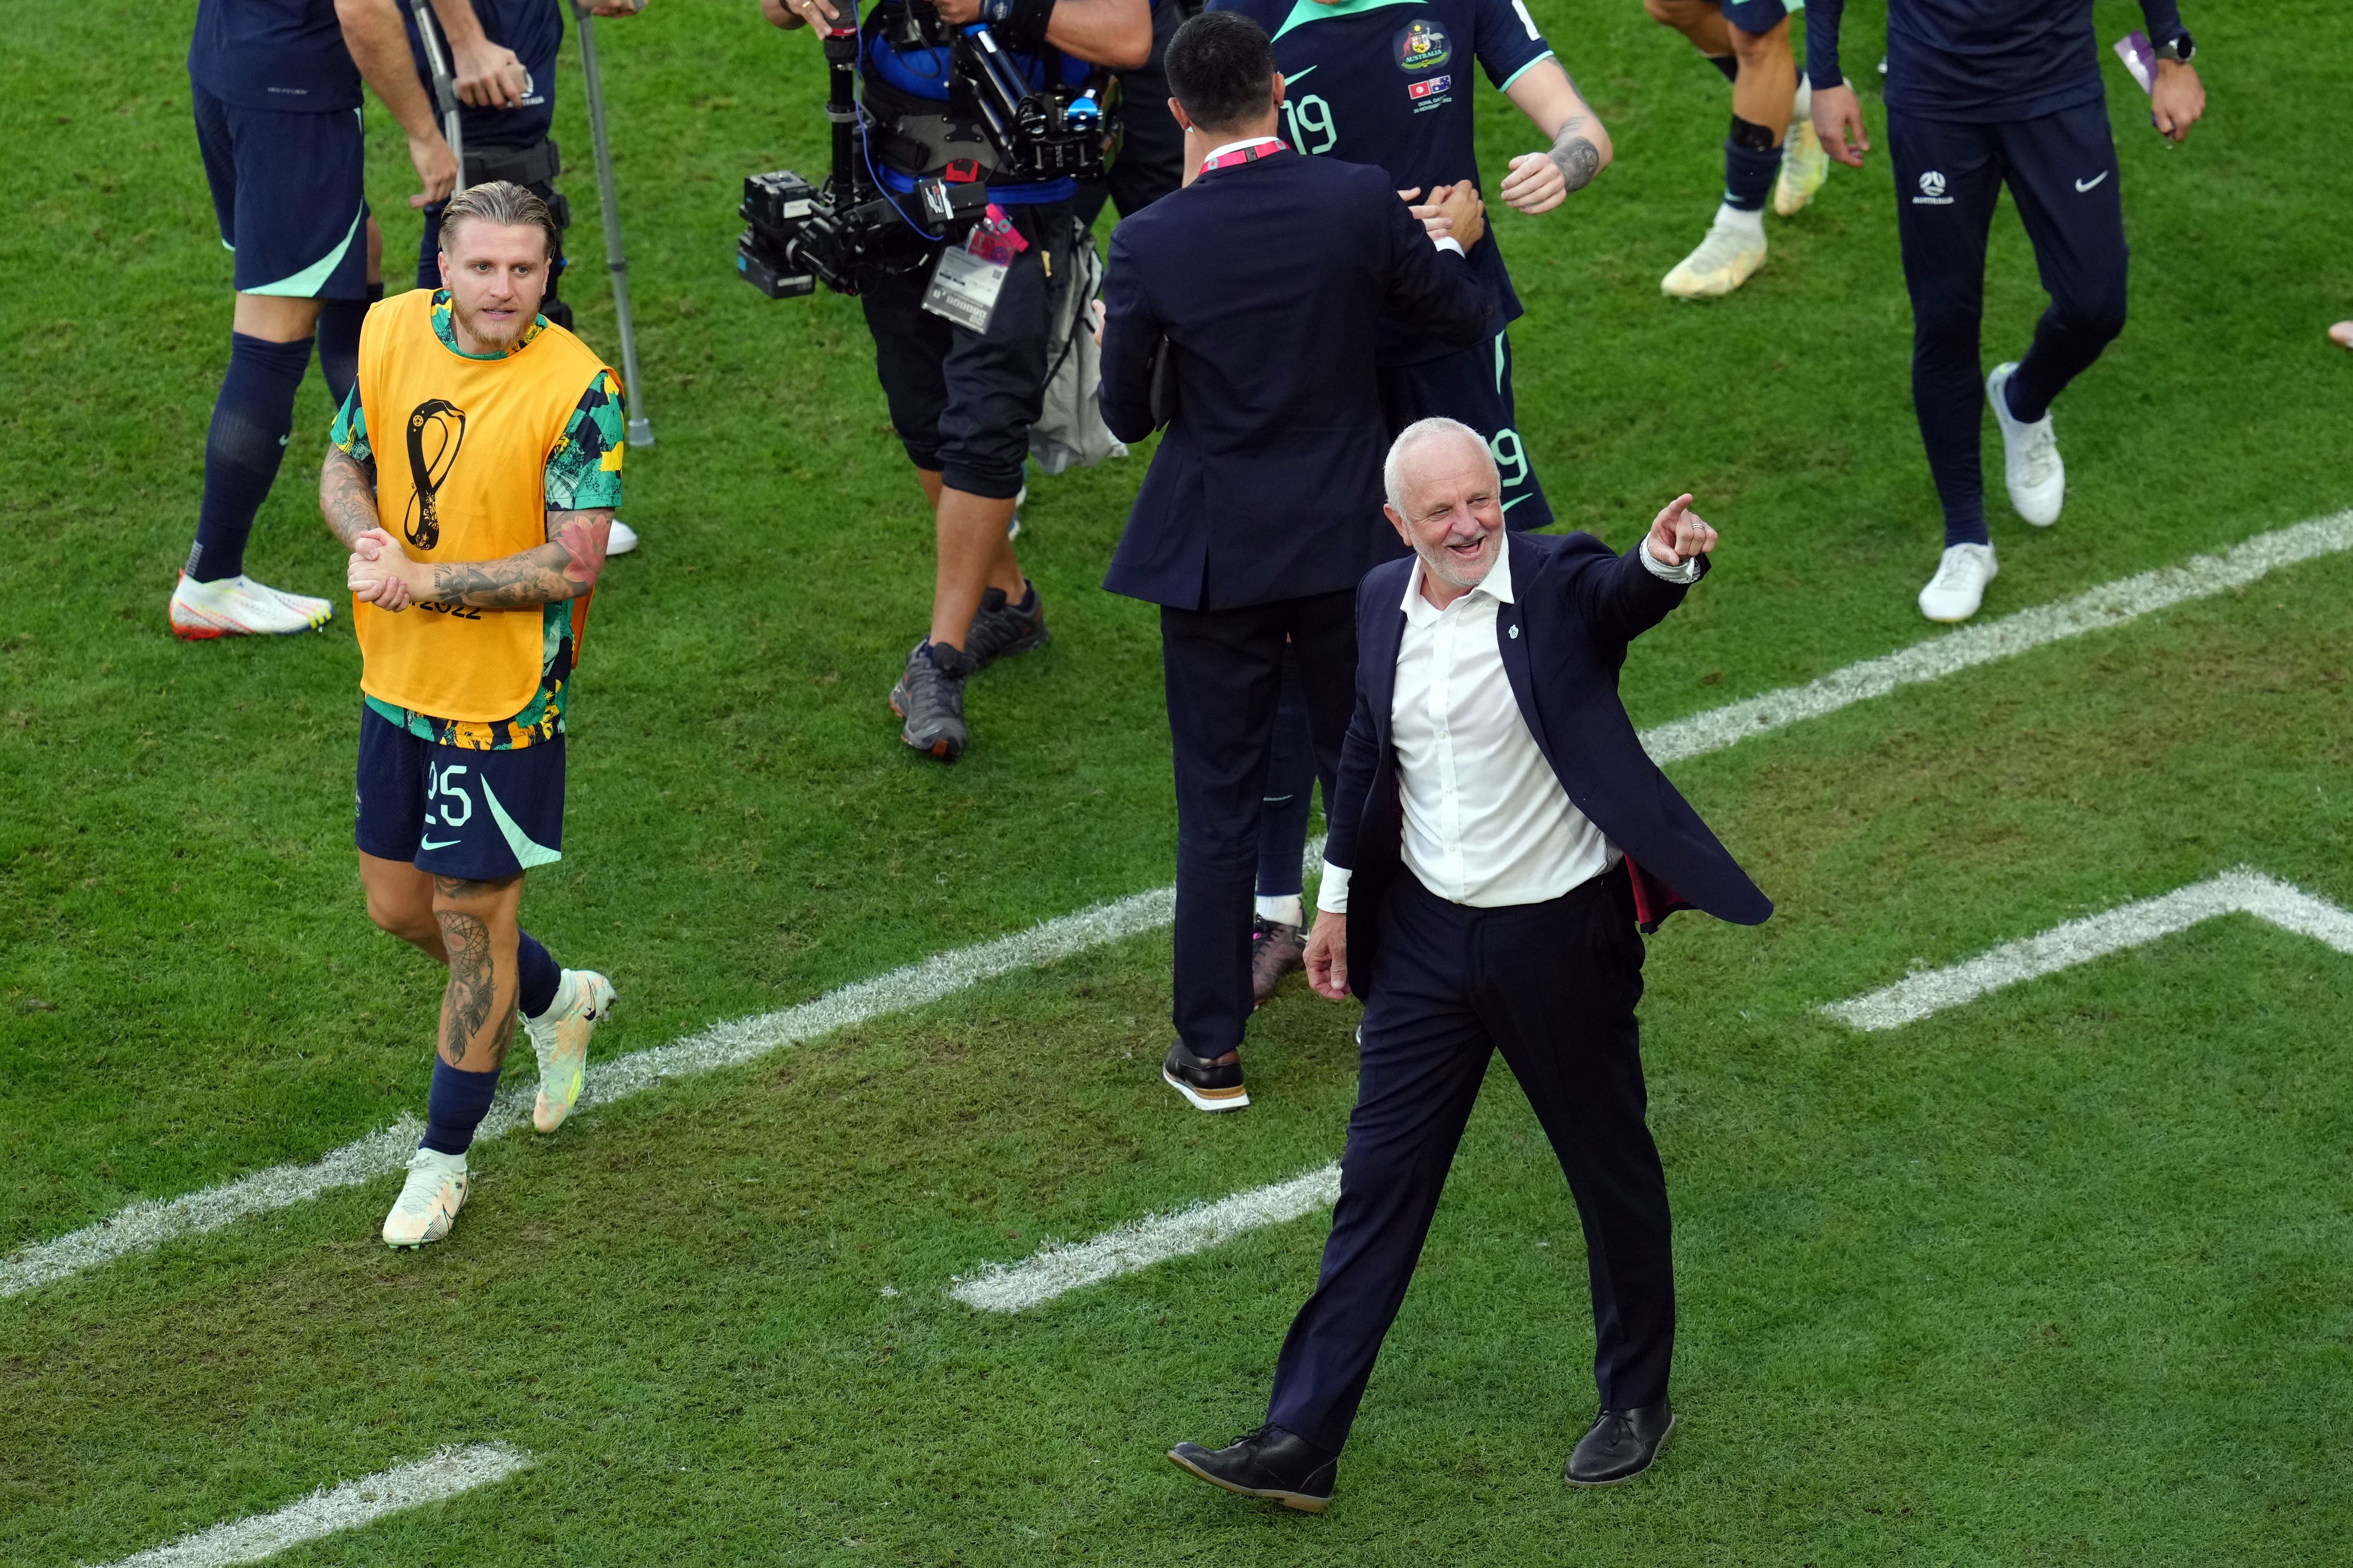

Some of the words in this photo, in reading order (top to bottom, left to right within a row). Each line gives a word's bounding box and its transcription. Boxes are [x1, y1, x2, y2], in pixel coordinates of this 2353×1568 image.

[1405, 49, 1443, 63] AUSTRALIA
[1279, 94, 1337, 155] 19
[1912, 196, 1954, 205] AUSTRALIA
[1481, 428, 1528, 487] 9
[425, 760, 472, 827] 25
